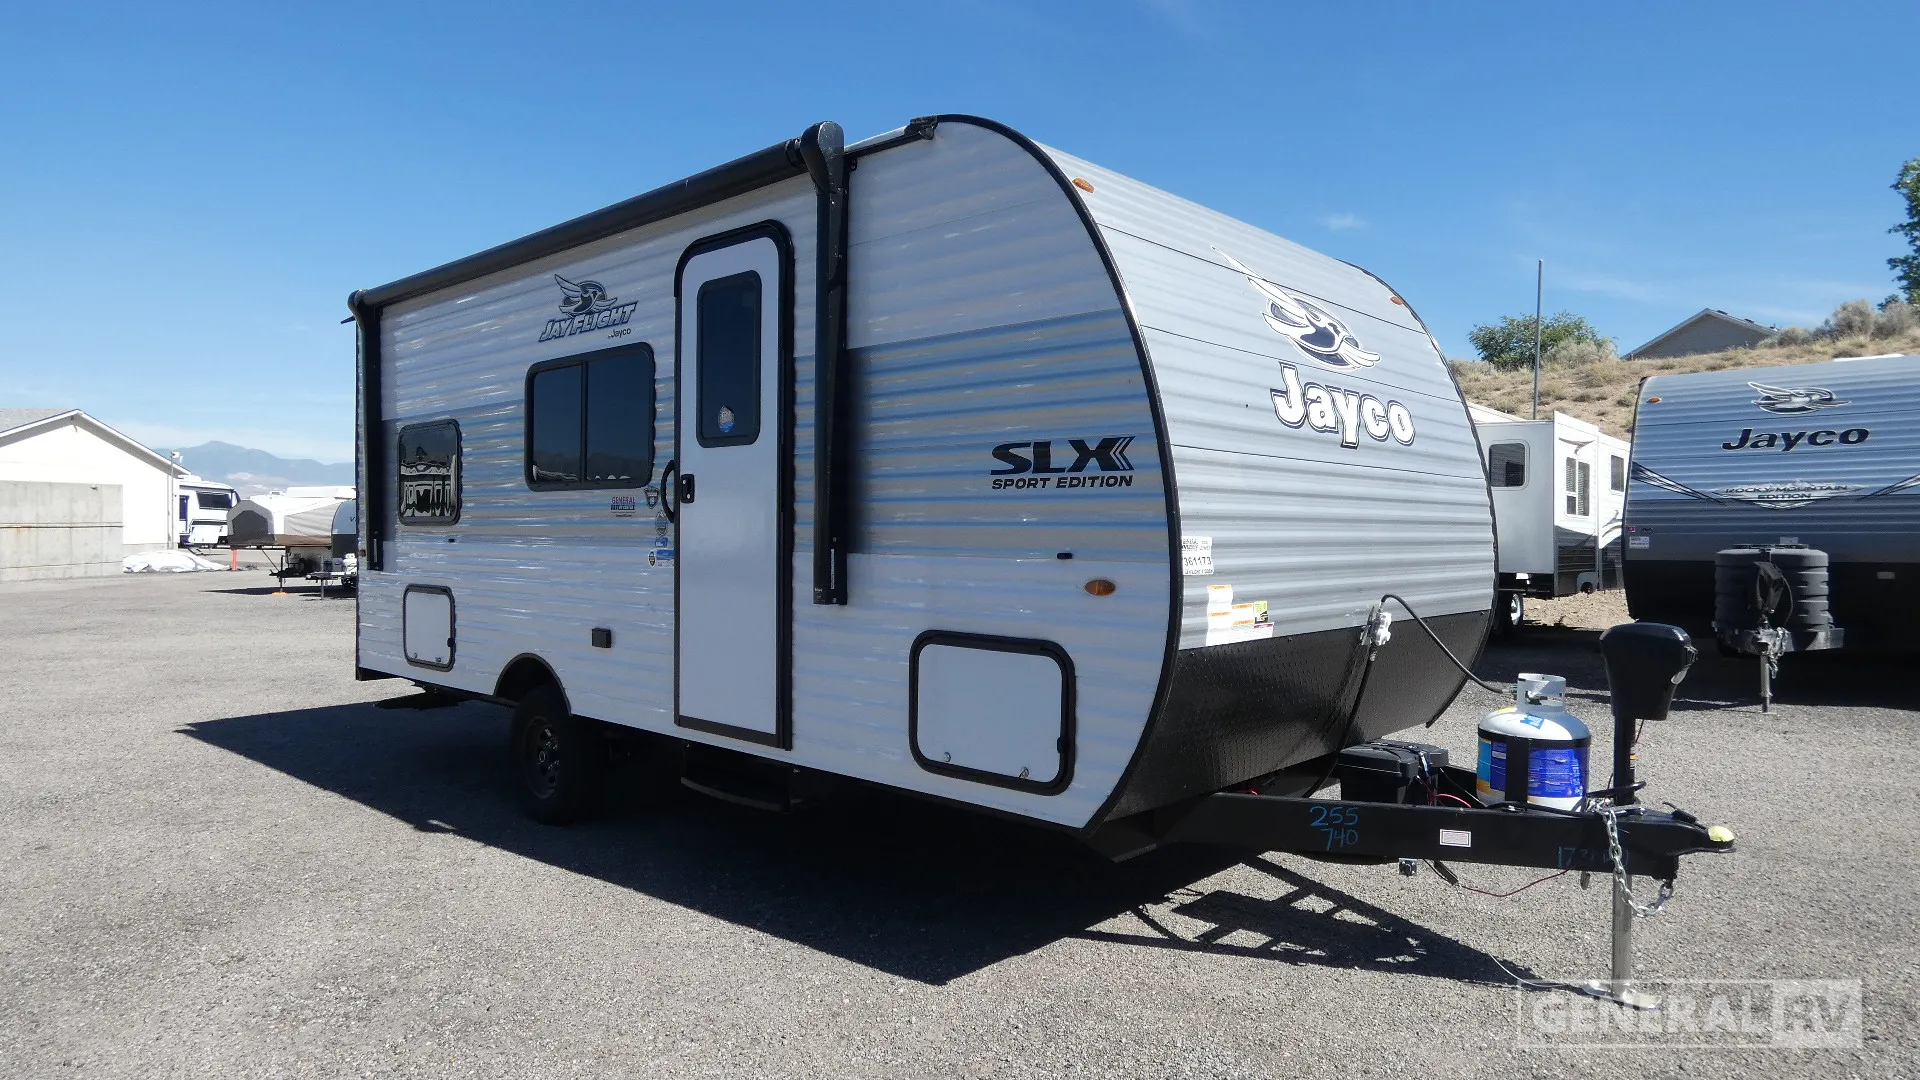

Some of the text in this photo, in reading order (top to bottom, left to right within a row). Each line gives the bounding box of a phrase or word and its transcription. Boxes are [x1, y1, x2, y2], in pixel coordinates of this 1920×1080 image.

[1270, 361, 1416, 450] Jayco
[1721, 428, 1870, 451] Jayco
[990, 436, 1136, 475] SLX
[992, 475, 1133, 490] SPORT EDITION
[612, 496, 635, 504] GENERAL
[1758, 492, 1812, 500] EDITION
[1184, 556, 1212, 567] 361173
[1309, 806, 1360, 827] 255
[1319, 826, 1359, 851] 740
